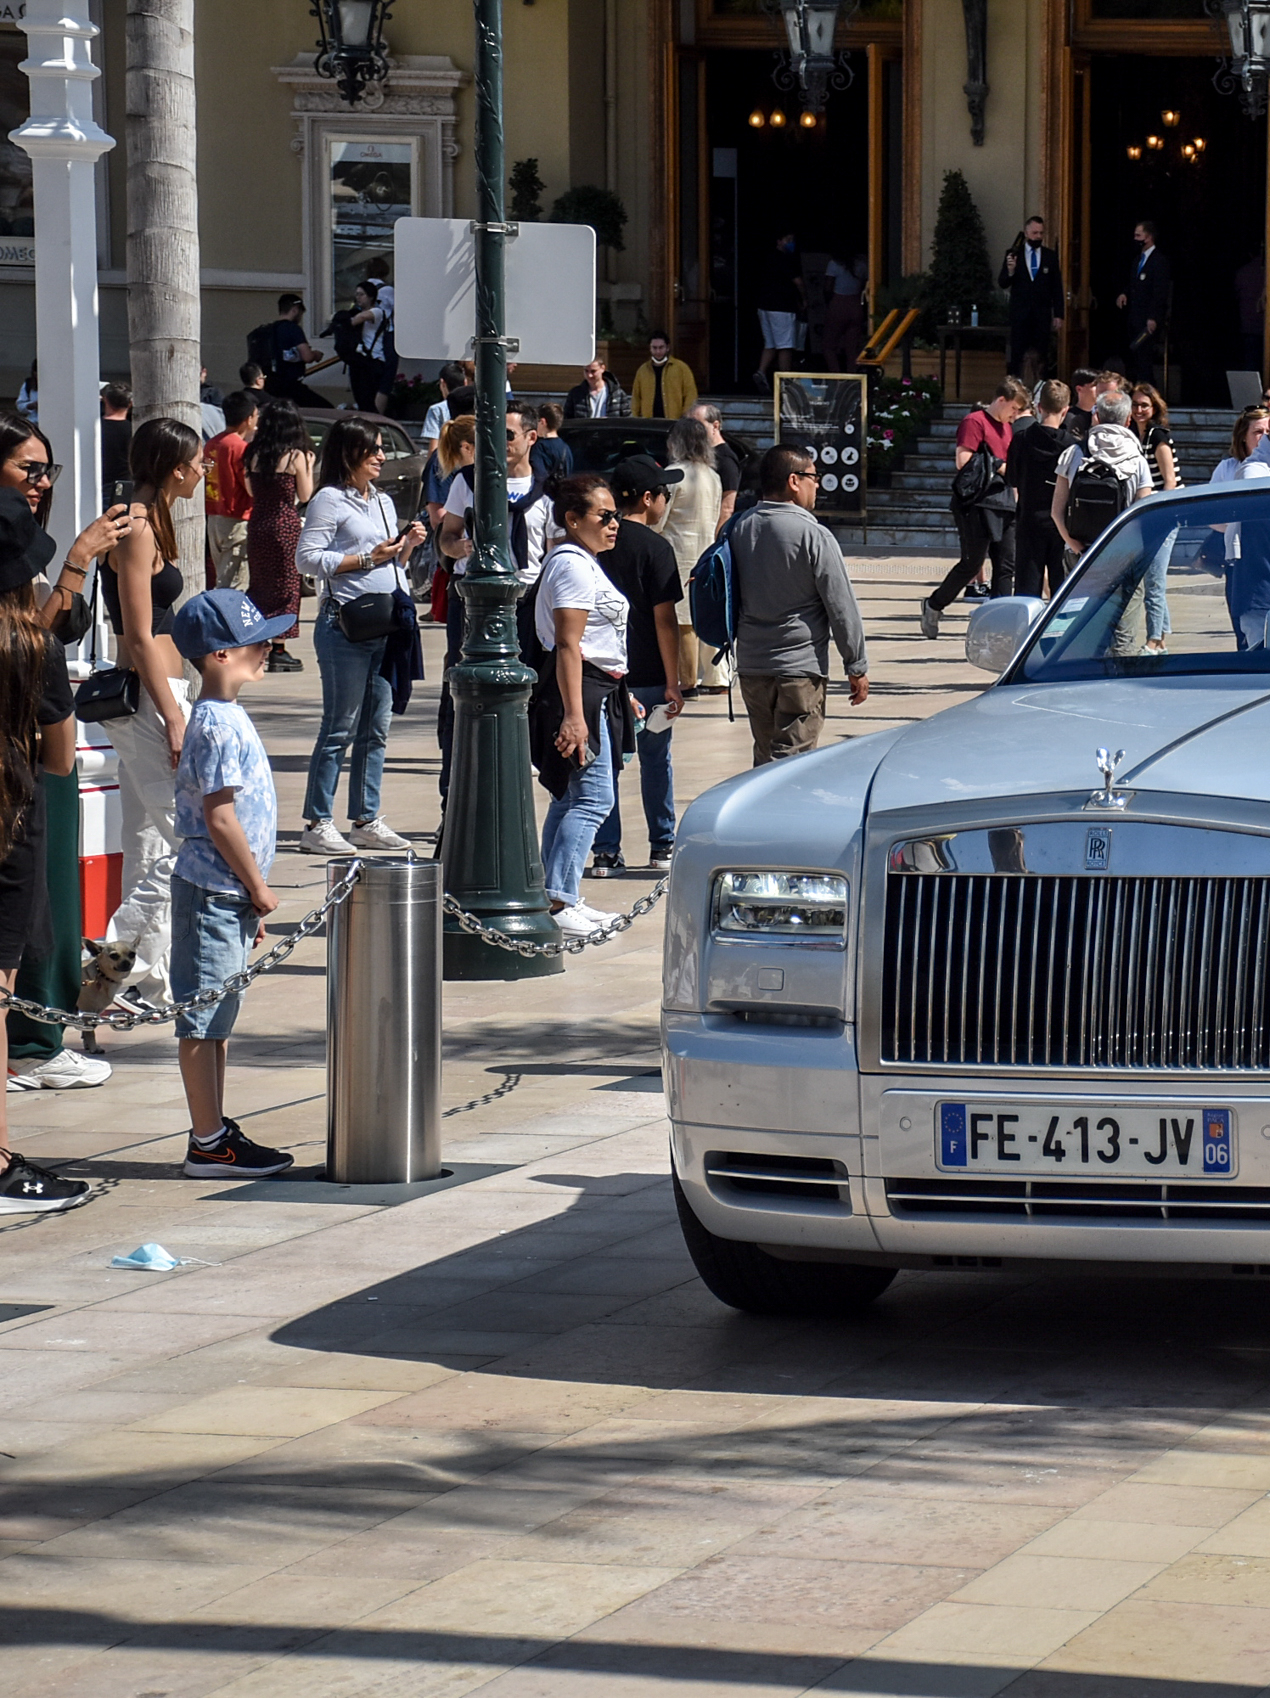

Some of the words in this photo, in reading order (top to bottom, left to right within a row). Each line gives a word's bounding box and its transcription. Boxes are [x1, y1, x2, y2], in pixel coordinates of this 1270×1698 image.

[241, 601, 254, 627] NEW
[950, 1141, 959, 1154] F
[970, 1113, 1194, 1165] FE-413-JV
[1205, 1143, 1228, 1165] 06
